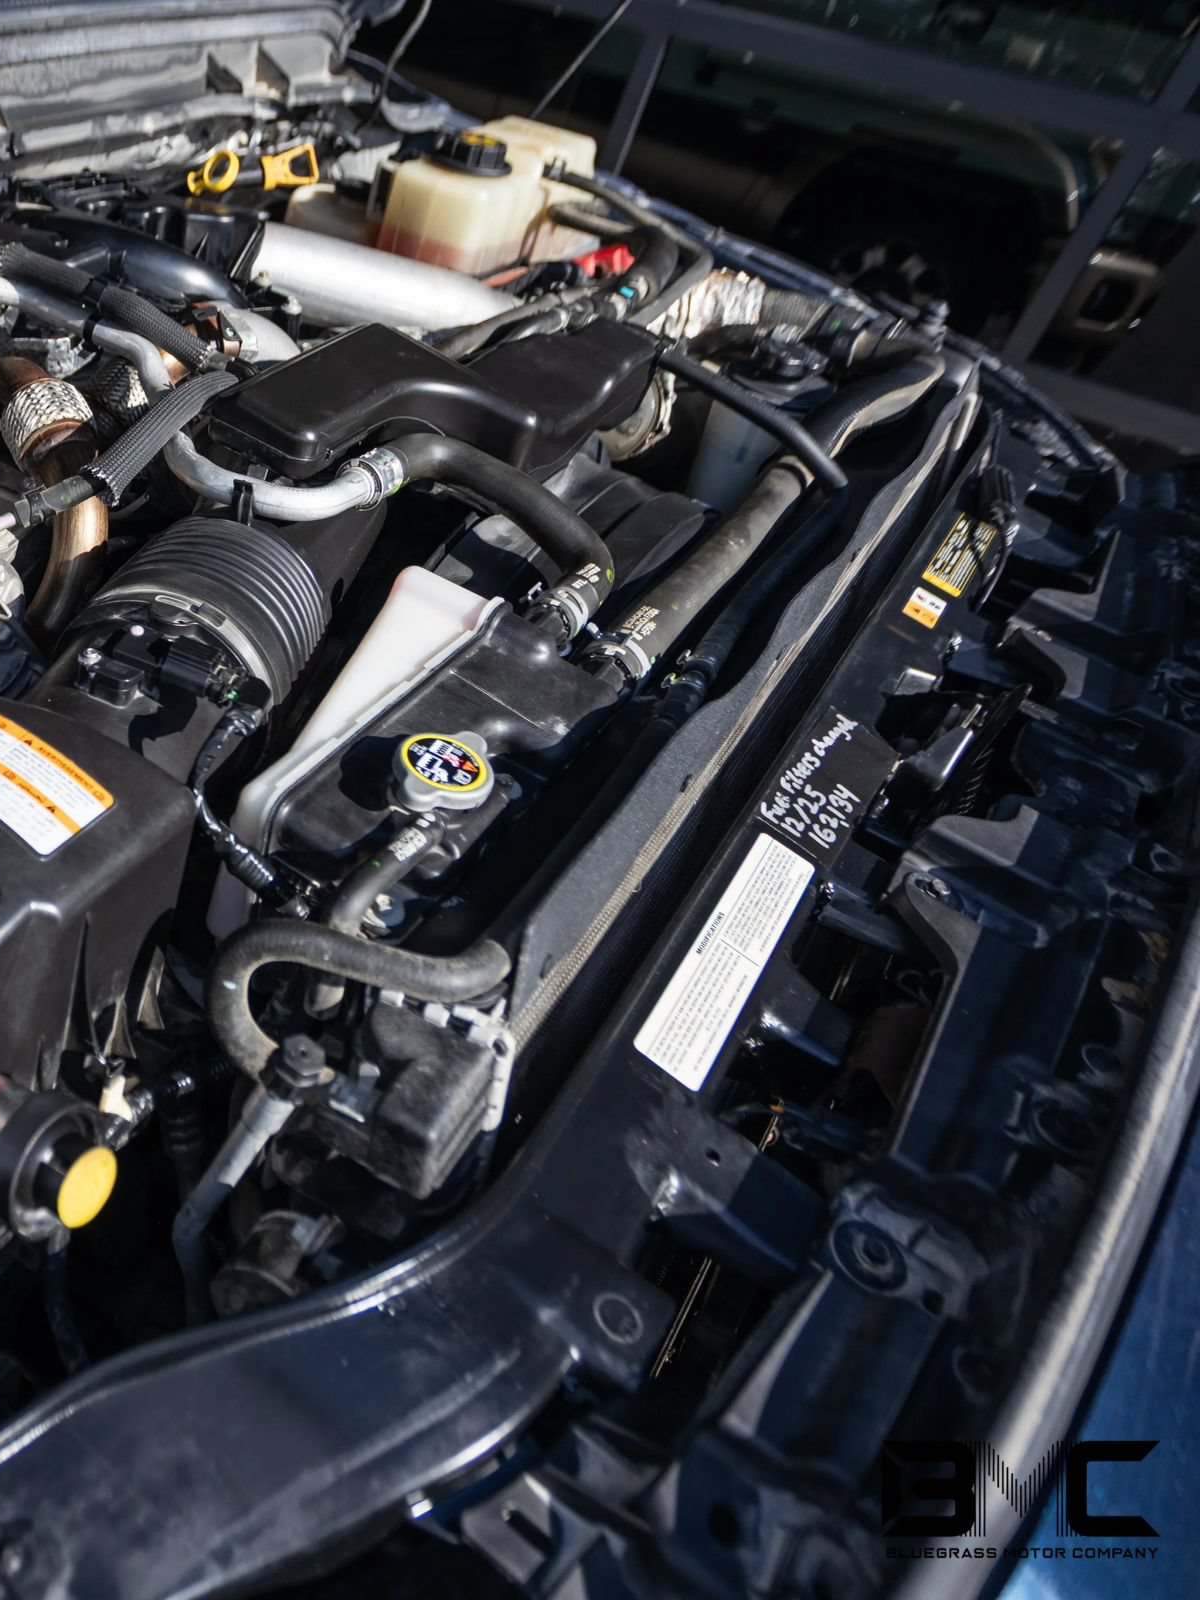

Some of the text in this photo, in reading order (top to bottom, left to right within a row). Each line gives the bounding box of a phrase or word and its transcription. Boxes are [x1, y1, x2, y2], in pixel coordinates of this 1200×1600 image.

[780, 784, 826, 837] 12/25
[808, 783, 860, 849] 162,134
[695, 911, 726, 956] MODIFICATIONS
